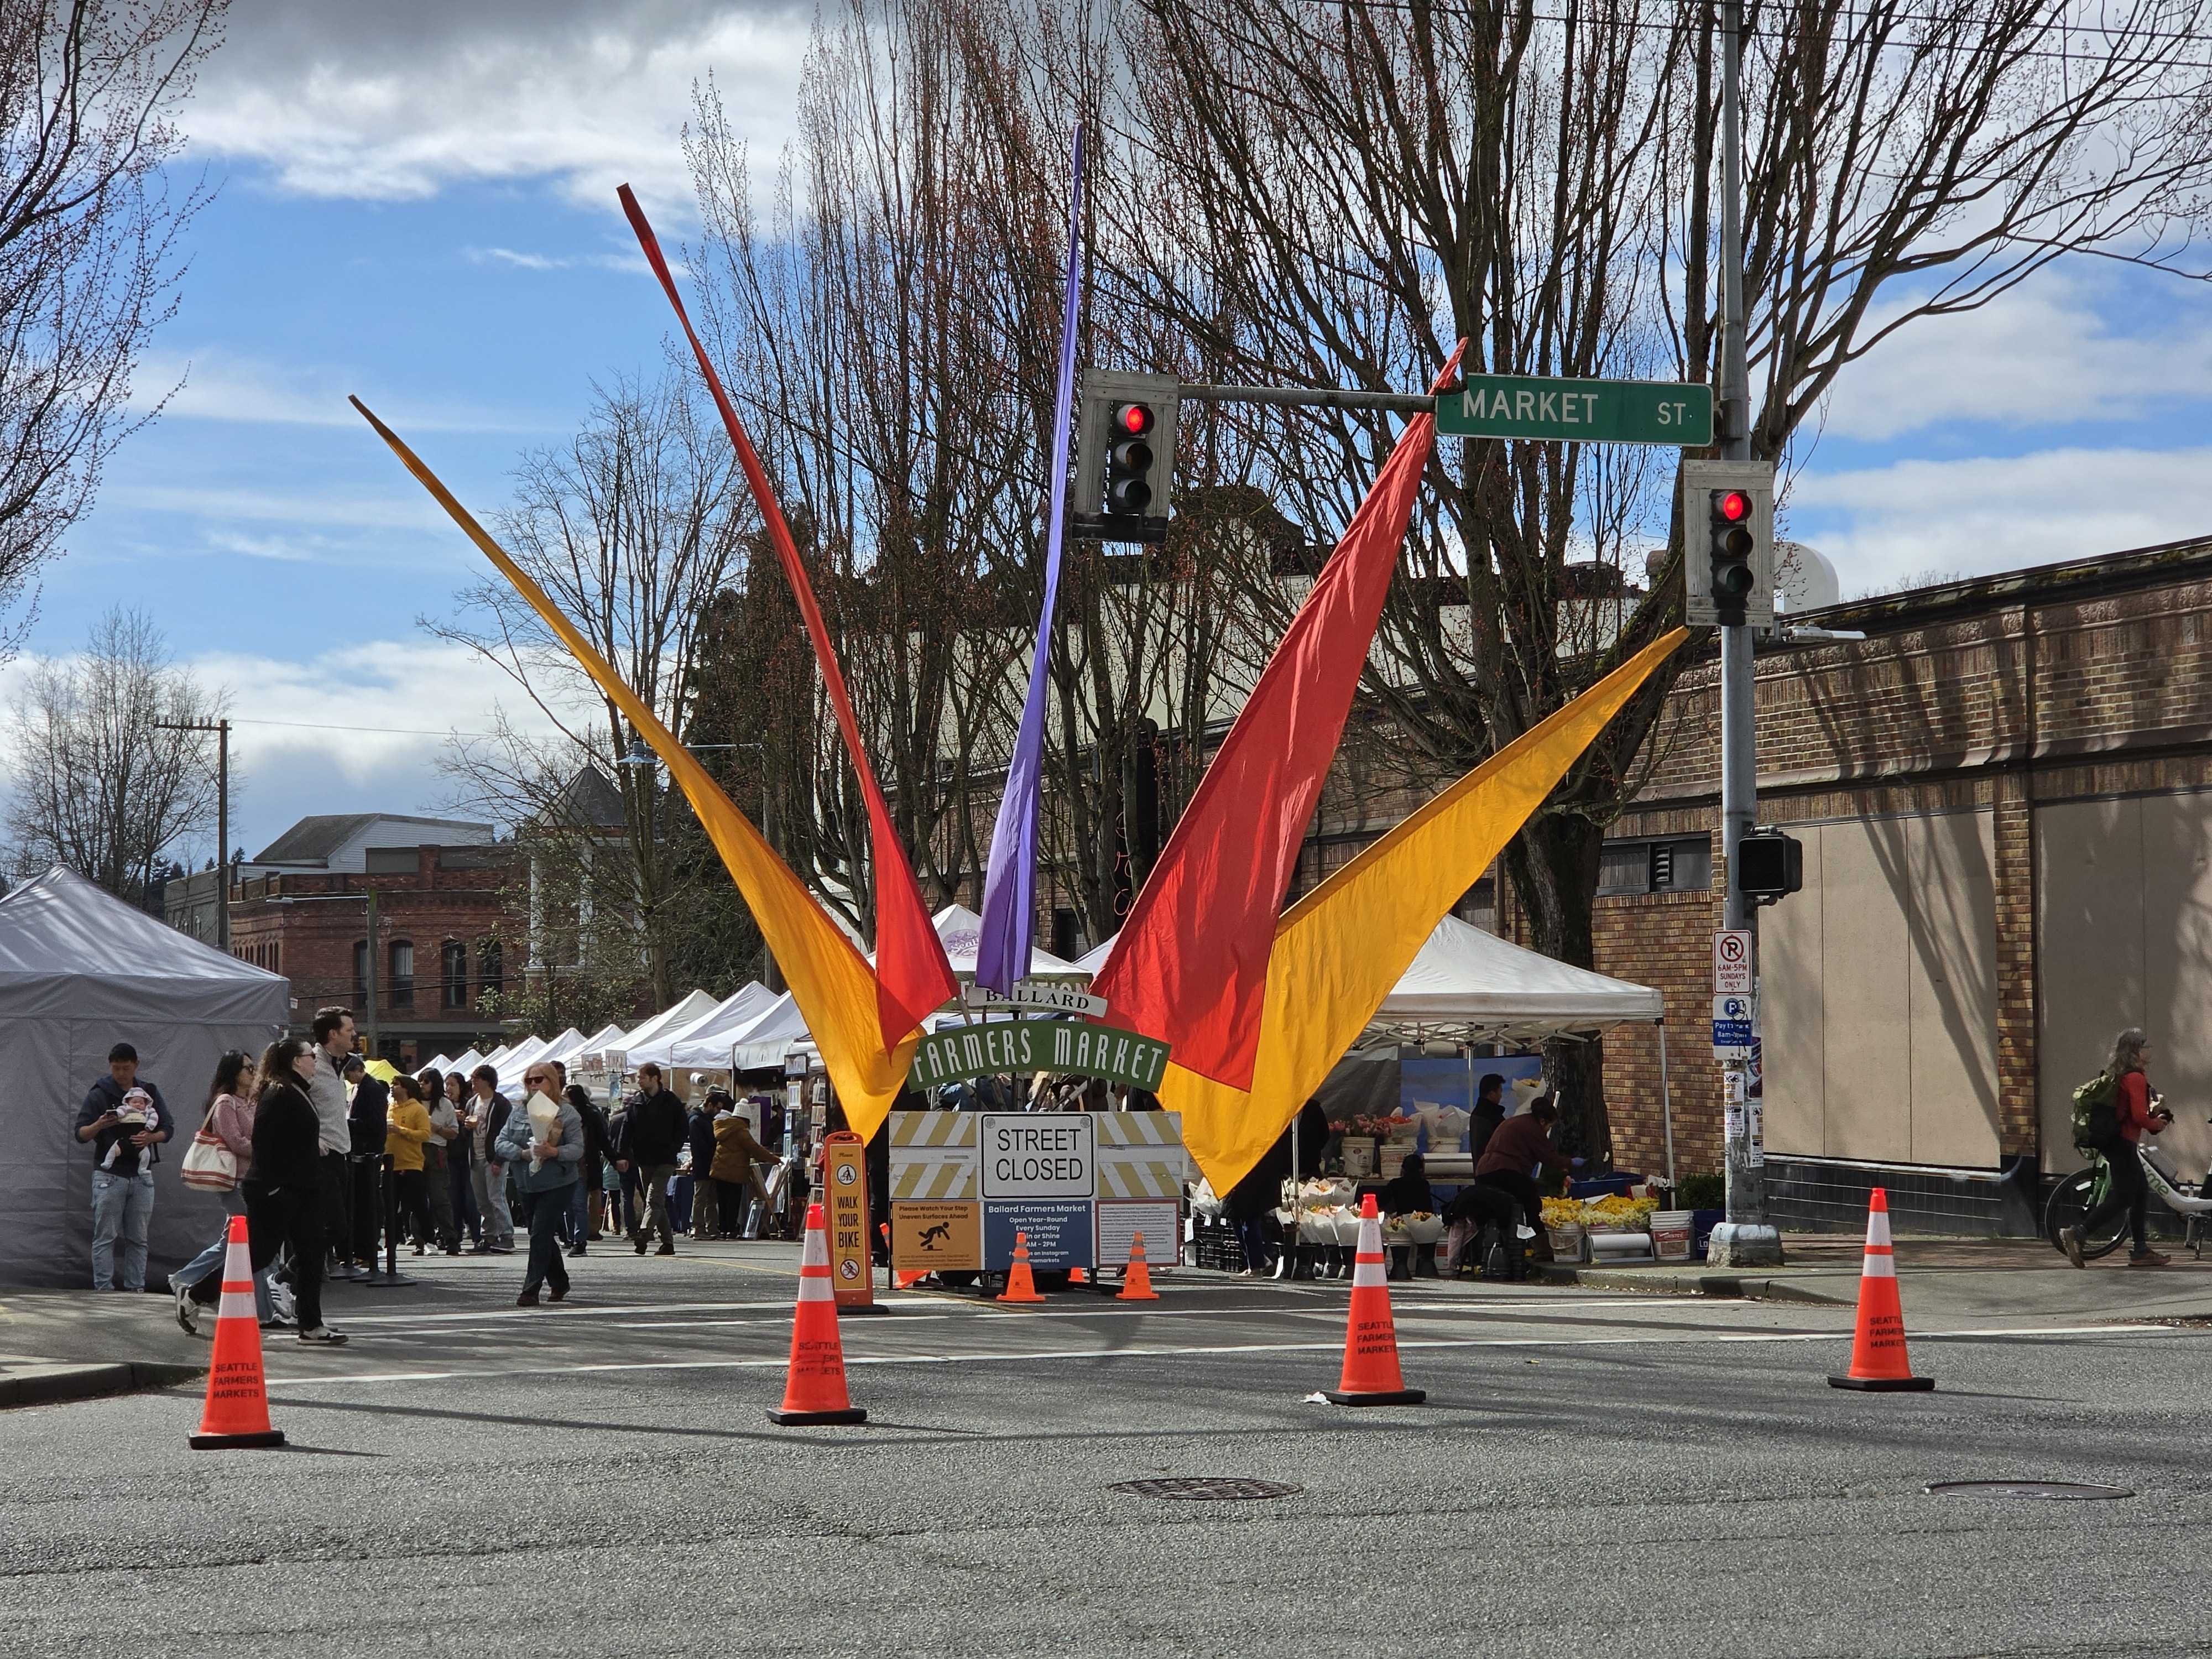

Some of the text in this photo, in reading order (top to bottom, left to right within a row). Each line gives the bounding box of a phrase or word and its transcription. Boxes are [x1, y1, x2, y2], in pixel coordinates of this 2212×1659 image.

[1463, 389, 1599, 424] MARKET
[914, 1027, 1163, 1083] FARMERS MARKET
[998, 1129, 1081, 1151] STREET
[996, 1158, 1083, 1181] CLOSED
[837, 1196, 858, 1209] WALK
[837, 1213, 859, 1227] YOUR
[838, 1231, 860, 1248] BIKE
[215, 1363, 257, 1373] SEATTLE
[213, 1376, 258, 1386] FARMERS
[213, 1389, 259, 1399] MARKETS
